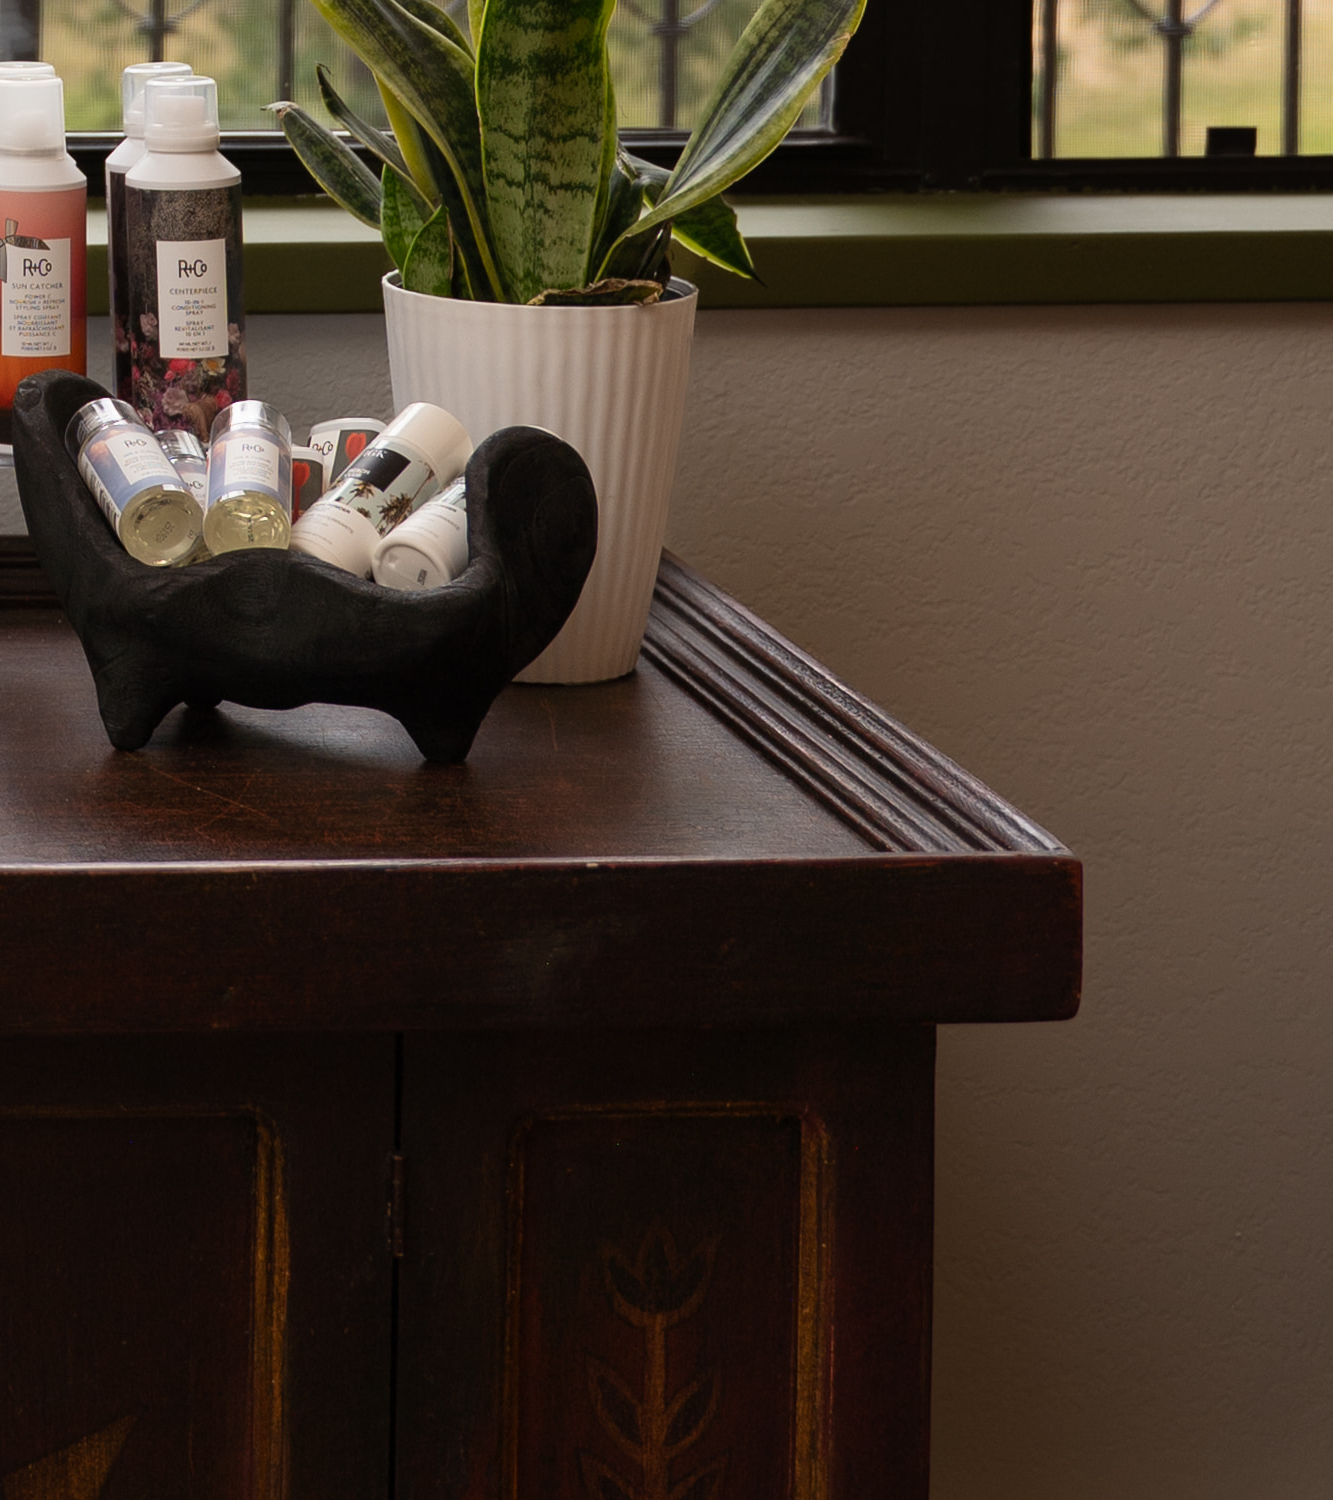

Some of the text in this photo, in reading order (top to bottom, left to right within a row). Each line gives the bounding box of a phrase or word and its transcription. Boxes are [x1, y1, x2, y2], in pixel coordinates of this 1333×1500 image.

[23, 258, 52, 277] R+Co
[178, 259, 207, 278] R+Co
[11, 282, 63, 290] SUN CATCHER
[169, 287, 218, 295] CENTERPIECE
